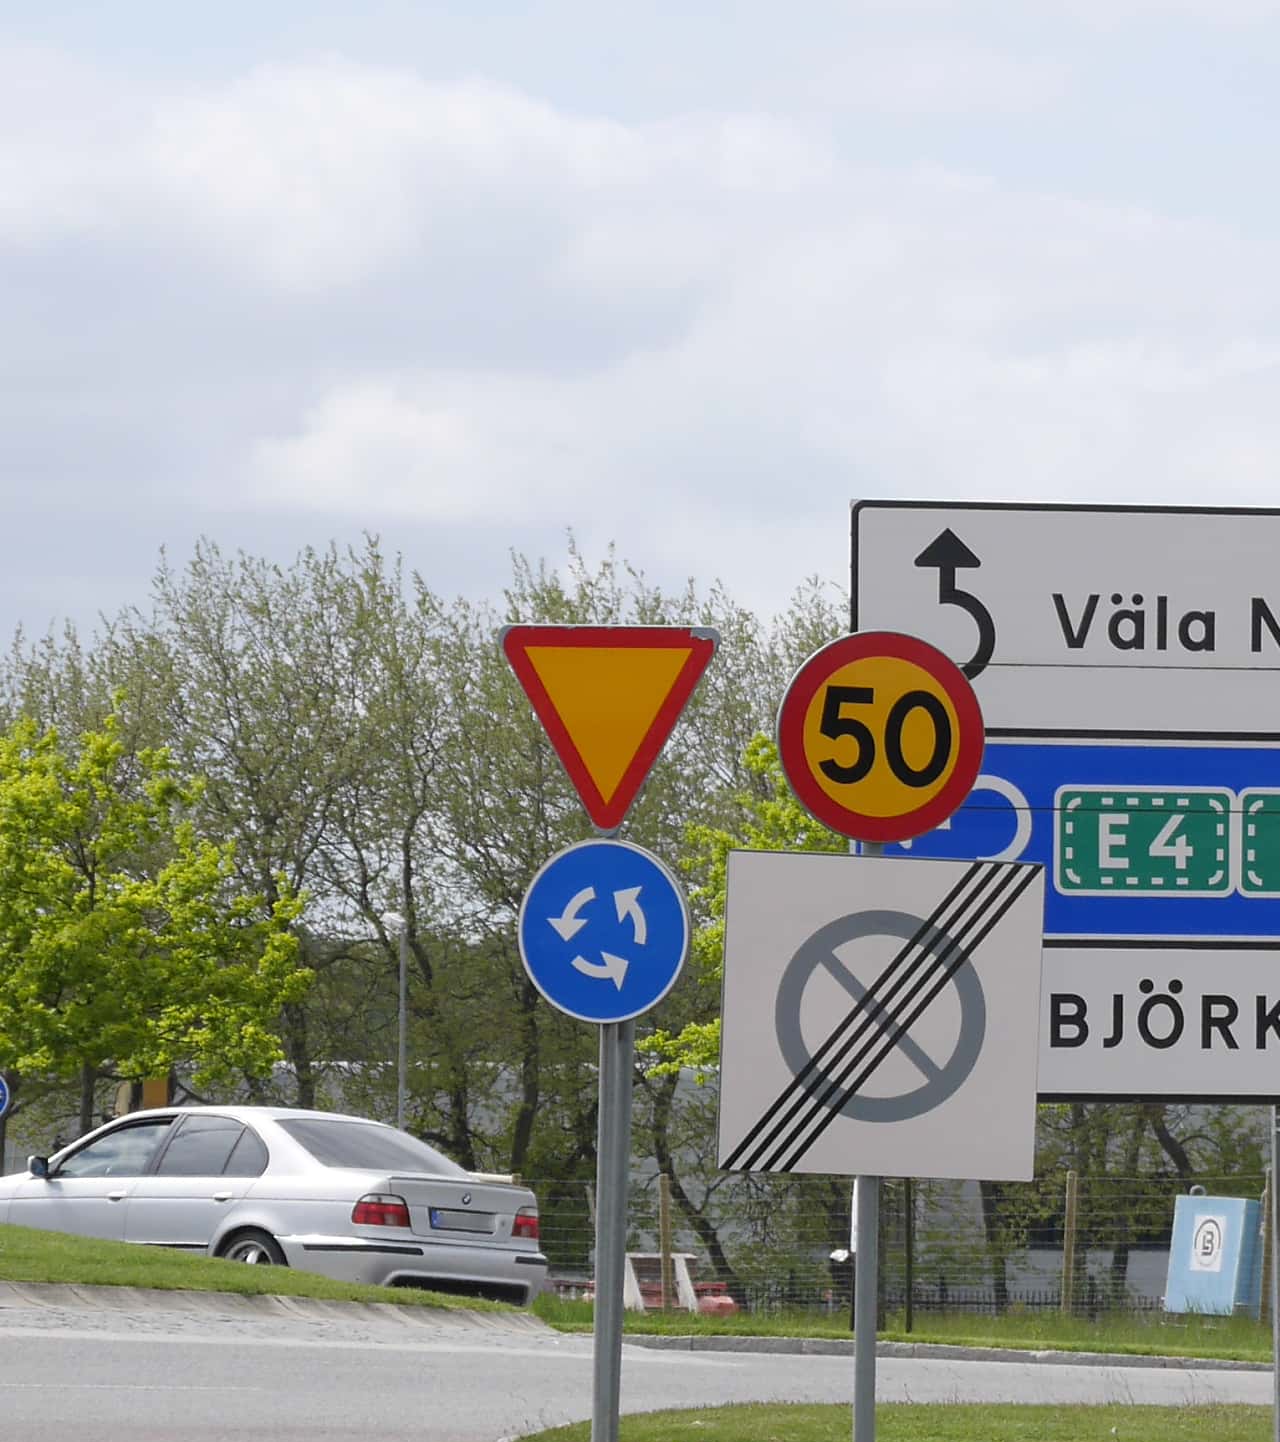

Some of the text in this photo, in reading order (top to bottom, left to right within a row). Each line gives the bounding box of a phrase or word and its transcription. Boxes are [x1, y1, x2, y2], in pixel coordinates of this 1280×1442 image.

[1052, 593, 1215, 652] Väla
[819, 685, 952, 788] 50
[1098, 813, 1194, 871] E4
